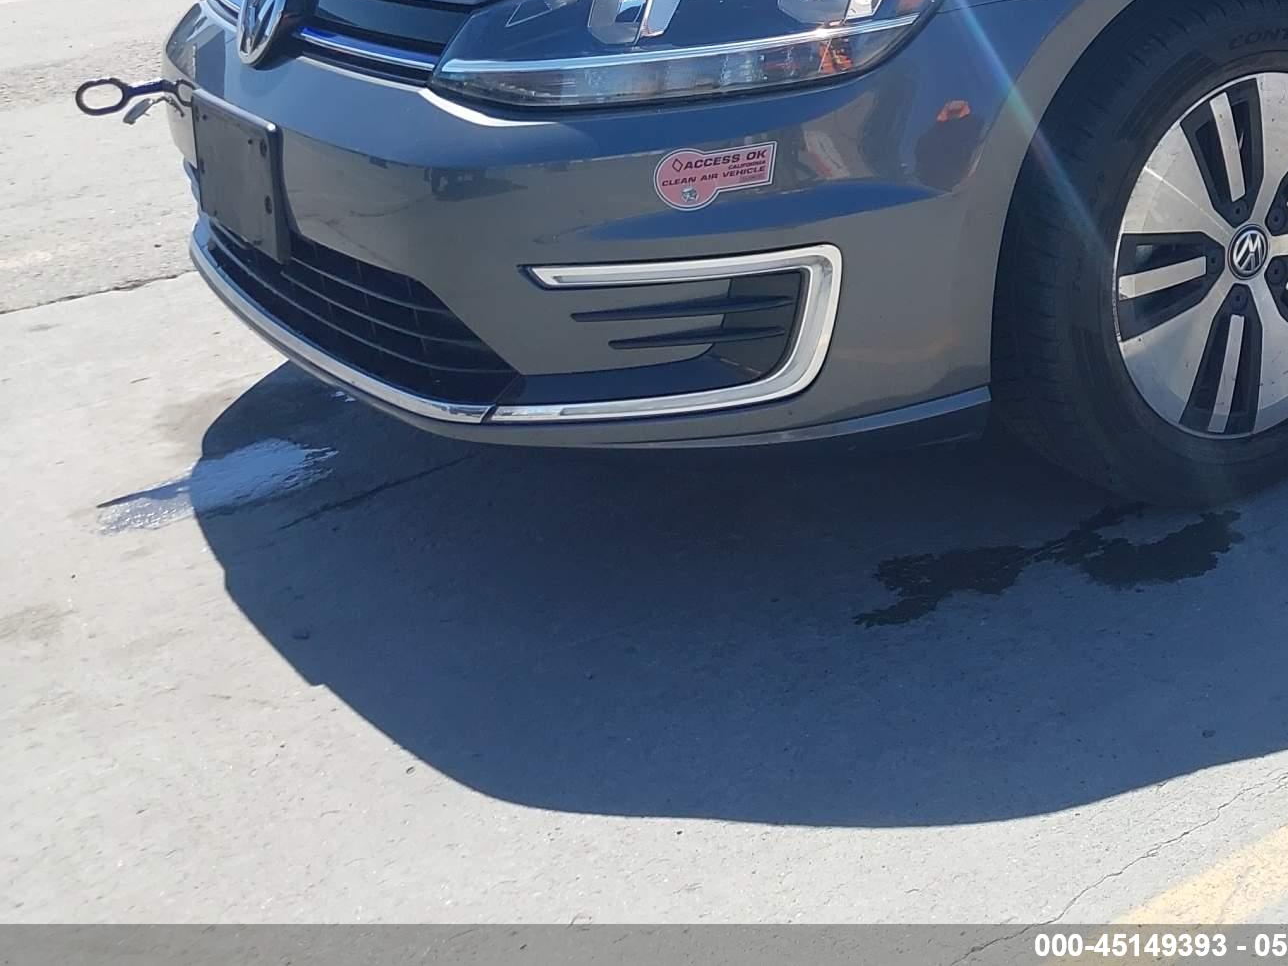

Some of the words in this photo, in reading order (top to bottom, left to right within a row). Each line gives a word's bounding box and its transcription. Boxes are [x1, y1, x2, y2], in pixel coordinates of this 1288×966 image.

[683, 154, 741, 171] ACCESS
[746, 149, 768, 160] OK
[728, 160, 766, 170] CALIFORNIA
[661, 176, 697, 187] CLEAN
[700, 173, 719, 181] AIR
[722, 165, 766, 178] VEHICLE
